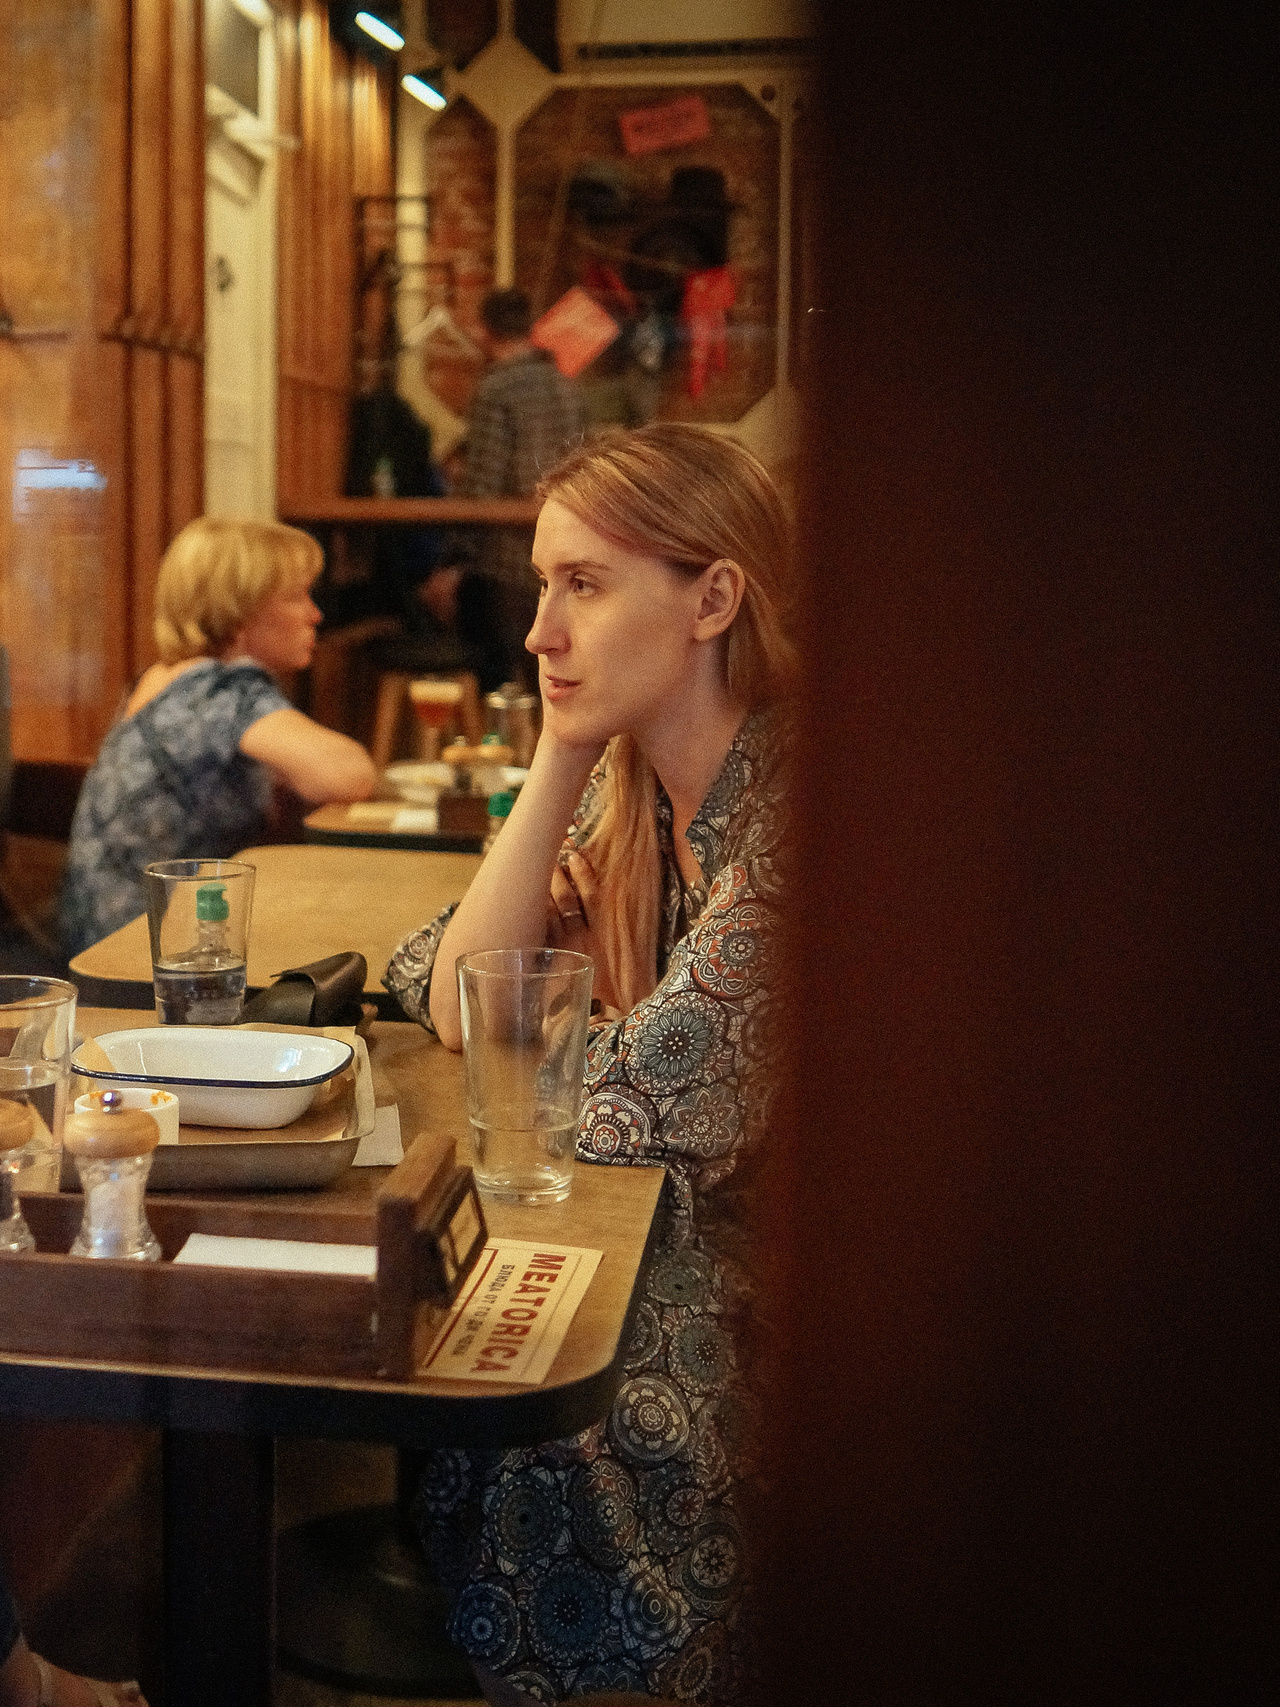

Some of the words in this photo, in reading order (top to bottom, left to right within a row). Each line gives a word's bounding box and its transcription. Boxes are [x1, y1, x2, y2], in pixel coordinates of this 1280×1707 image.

[489, 1264, 516, 1292] БЛЮДА
[470, 1252, 567, 1372] MEATORICA
[481, 1294, 498, 1304] ОТ
